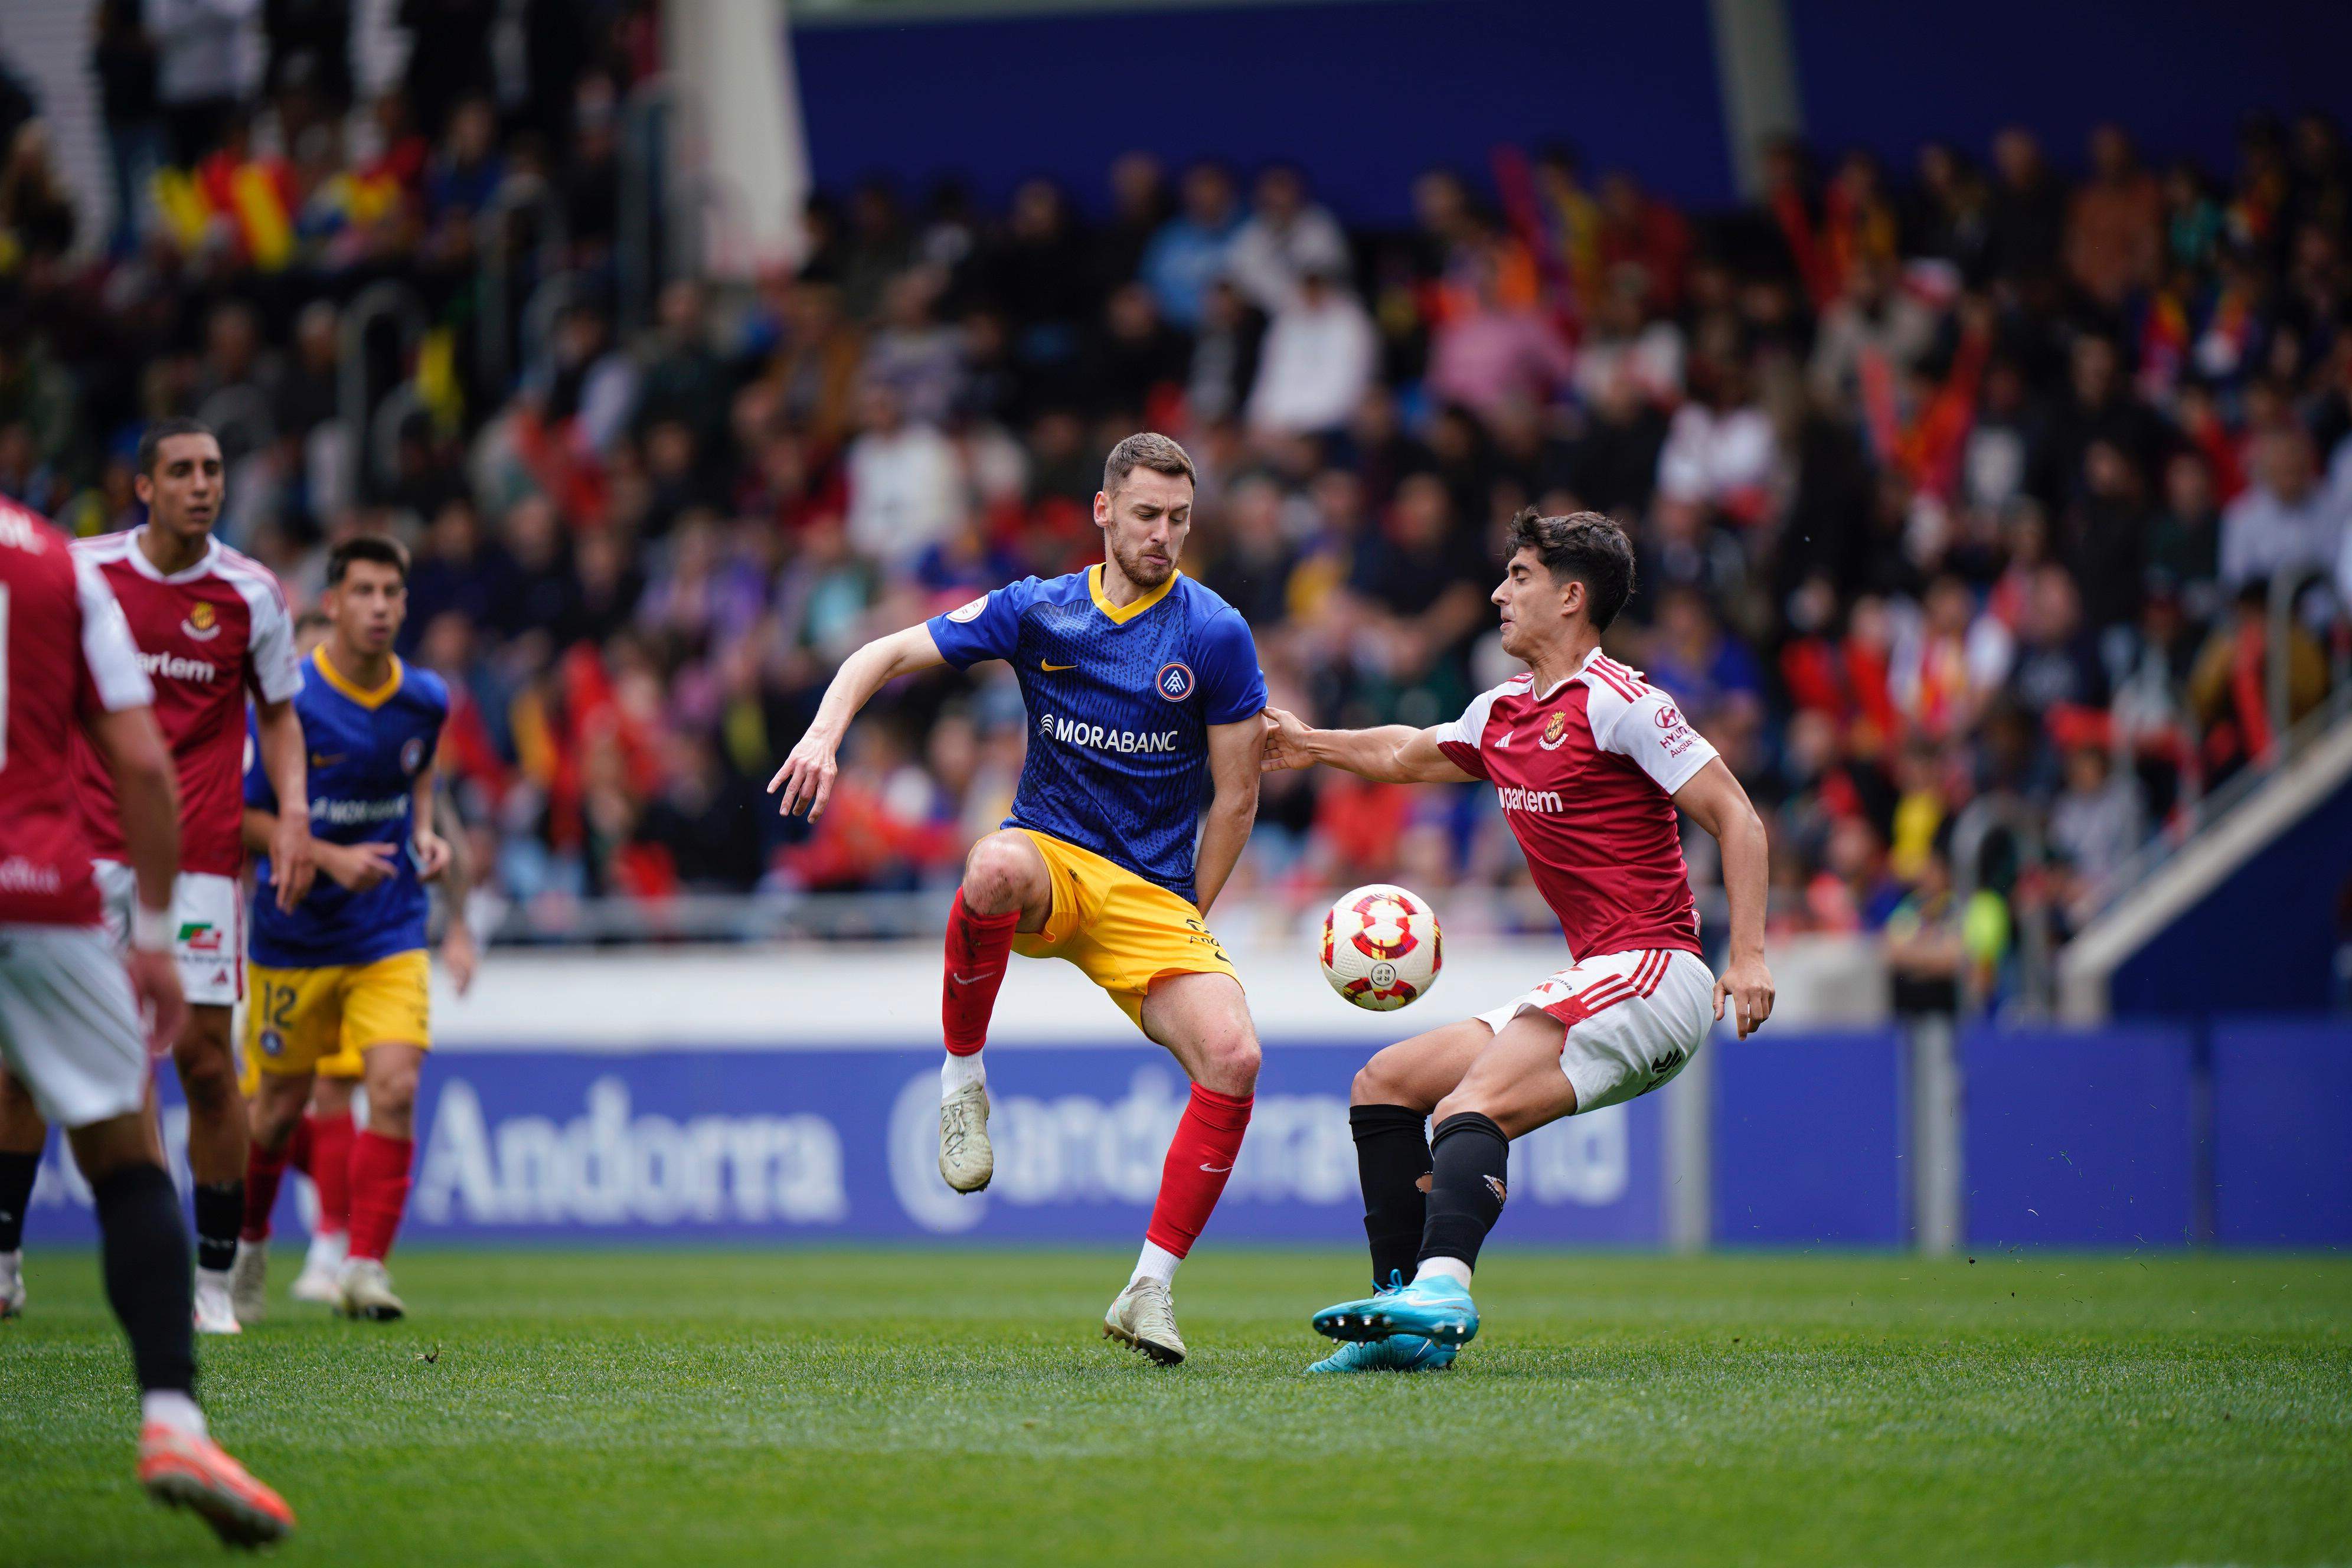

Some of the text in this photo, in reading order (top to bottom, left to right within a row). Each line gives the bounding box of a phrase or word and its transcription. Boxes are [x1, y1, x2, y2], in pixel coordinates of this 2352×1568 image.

[1055, 718, 1178, 753] MORABANC
[1538, 733, 1569, 751] TARRAGONA
[1660, 725, 1690, 749] HYUN
[1504, 784, 1563, 816] parlem
[263, 981, 297, 1030] 12
[416, 1076, 848, 1225] Andorra
